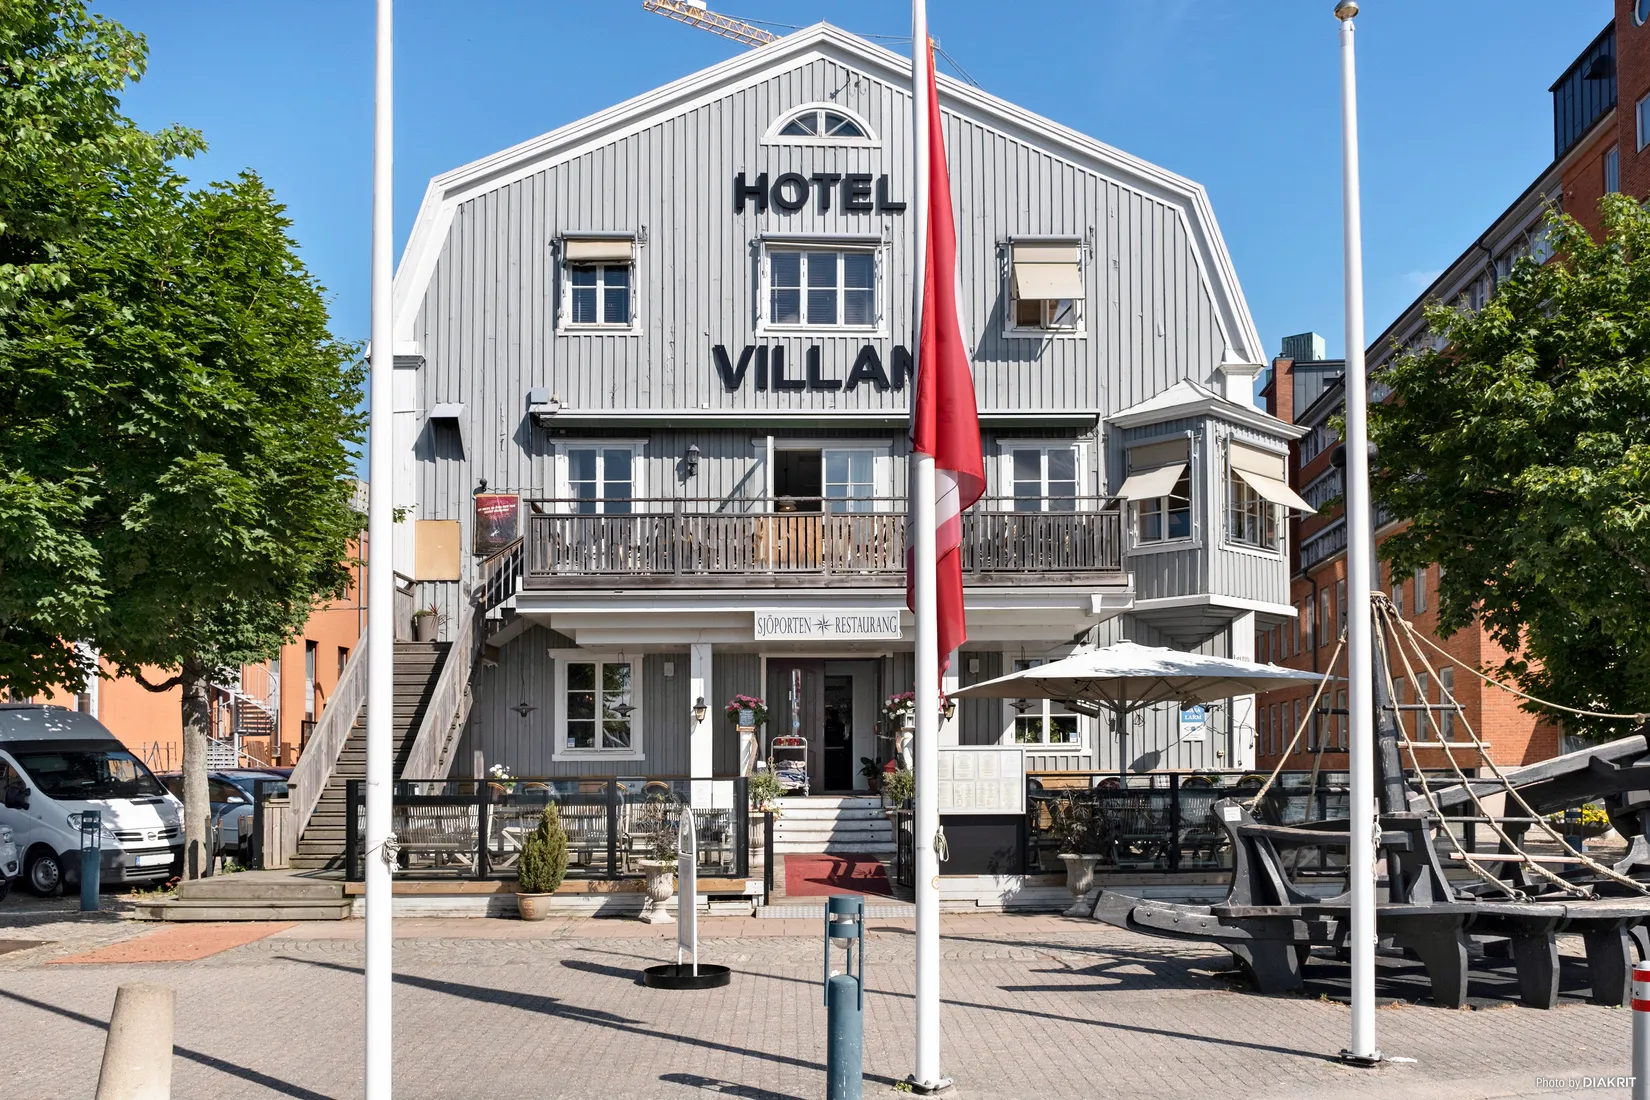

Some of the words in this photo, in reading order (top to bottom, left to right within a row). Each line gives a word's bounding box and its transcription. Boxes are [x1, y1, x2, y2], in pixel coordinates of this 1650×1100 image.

[735, 172, 907, 210] HOTEL
[757, 614, 812, 637] SJÖPORTEN
[835, 616, 897, 634] RESTAURANG
